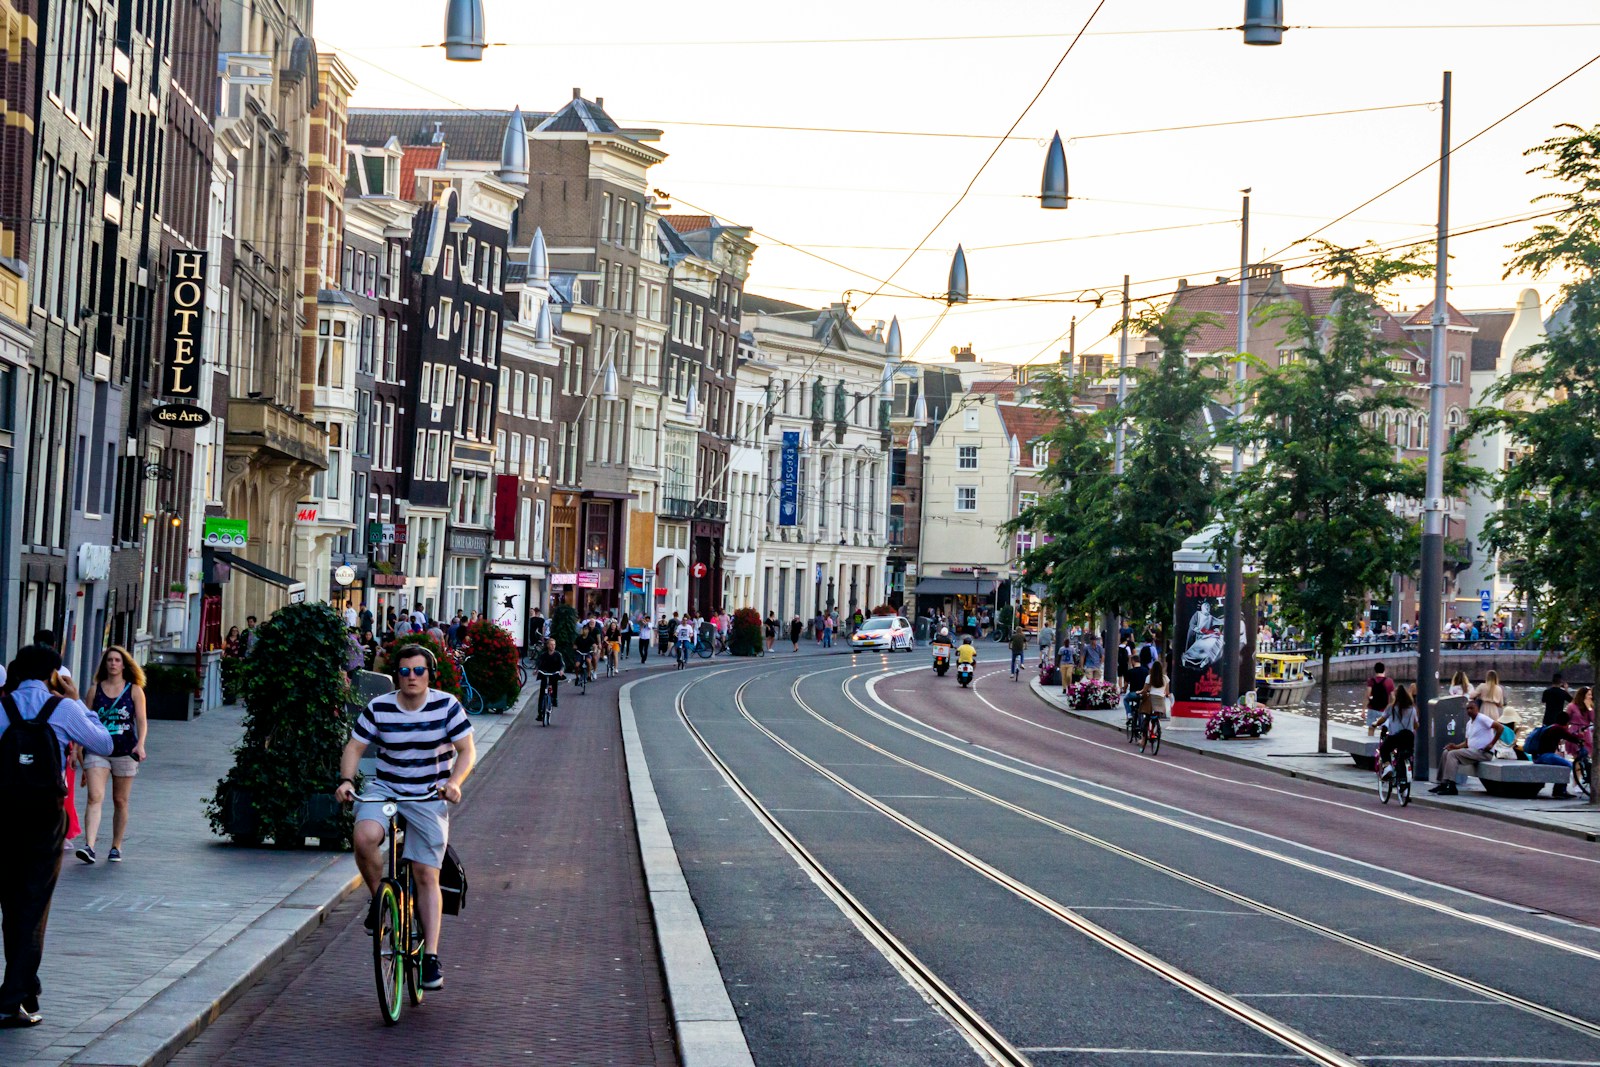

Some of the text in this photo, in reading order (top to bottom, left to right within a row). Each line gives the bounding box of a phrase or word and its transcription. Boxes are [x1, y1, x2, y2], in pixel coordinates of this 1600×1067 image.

[171, 252, 203, 394] HOTEL
[158, 409, 204, 422] des Arts
[296, 508, 316, 521] H&M
[218, 527, 246, 535] NOODLE
[1194, 576, 1209, 584] you
